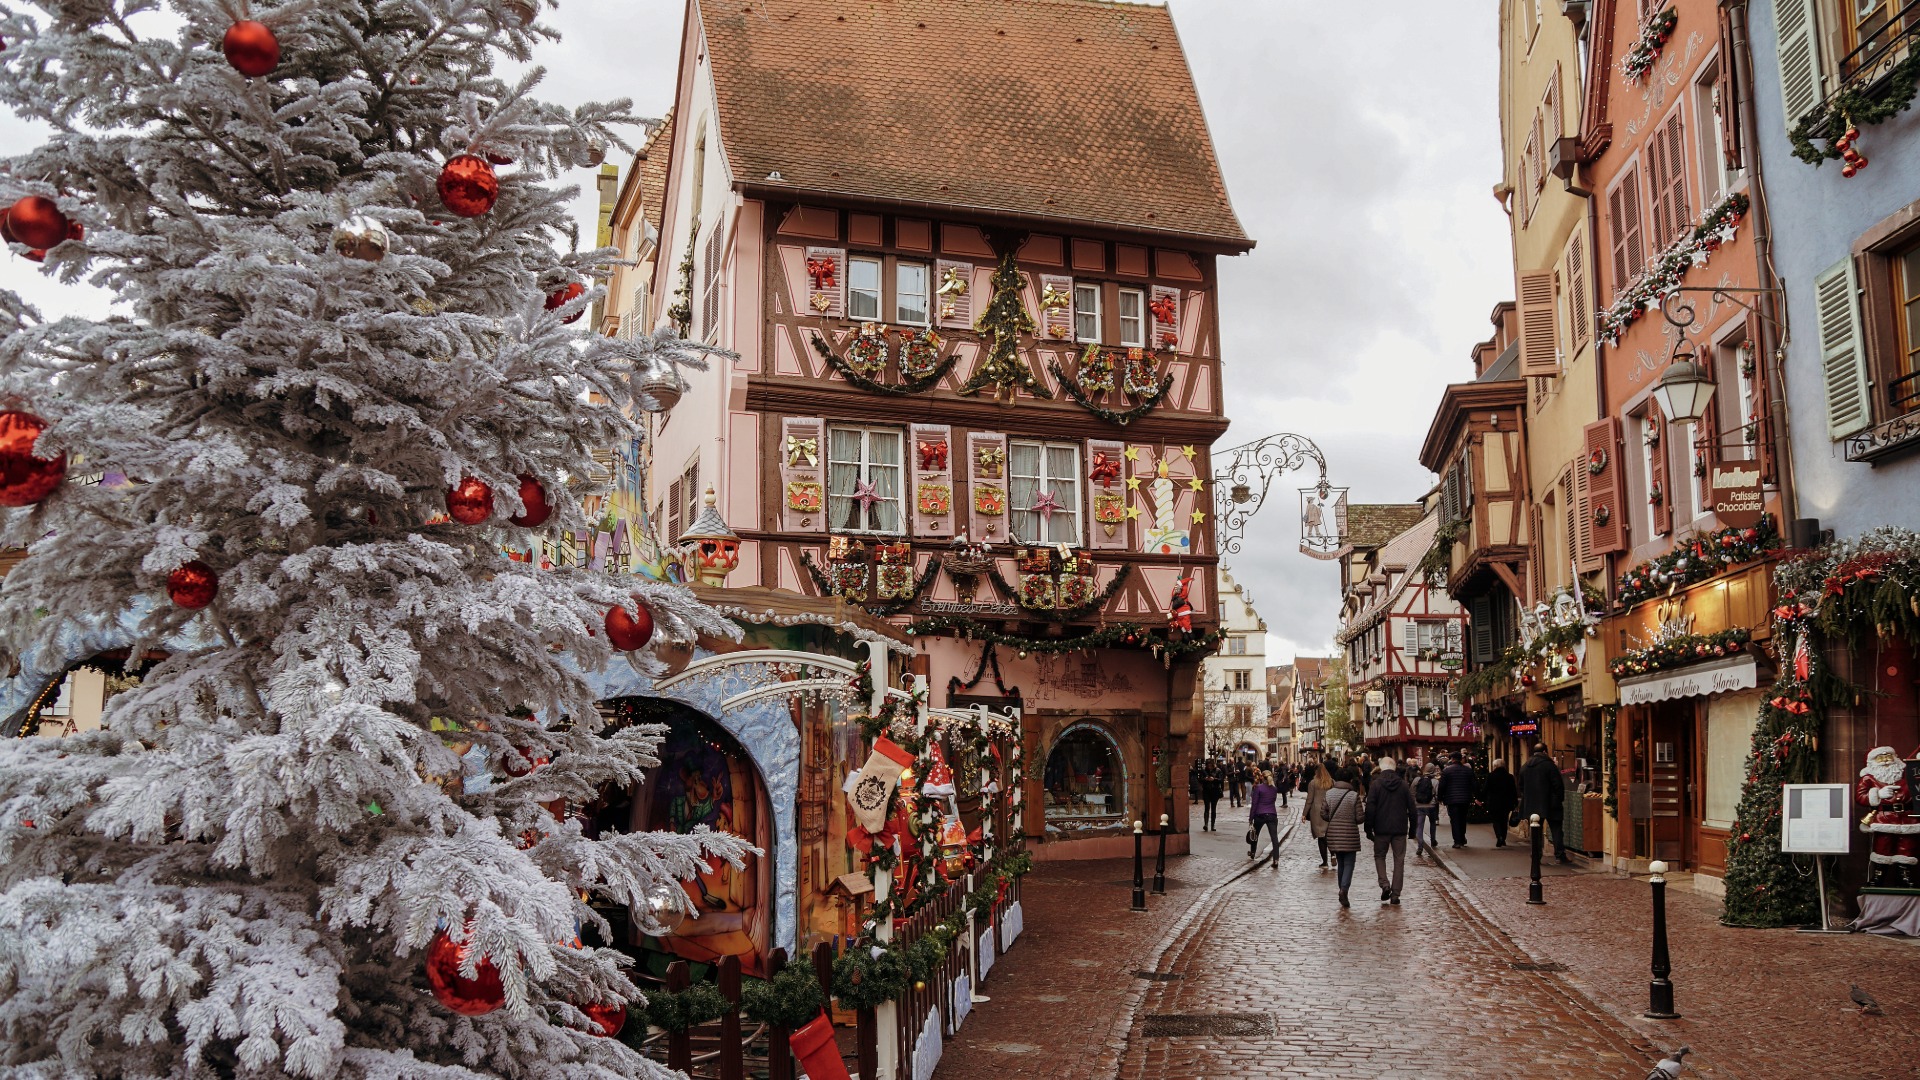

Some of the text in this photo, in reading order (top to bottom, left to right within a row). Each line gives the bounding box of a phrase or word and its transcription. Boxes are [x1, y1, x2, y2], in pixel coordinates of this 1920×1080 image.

[1713, 467, 1760, 488] Lorber
[1716, 501, 1762, 512] Chocolatier
[1662, 678, 1701, 698] Chocolatier
[1711, 673, 1741, 690] Glacier
